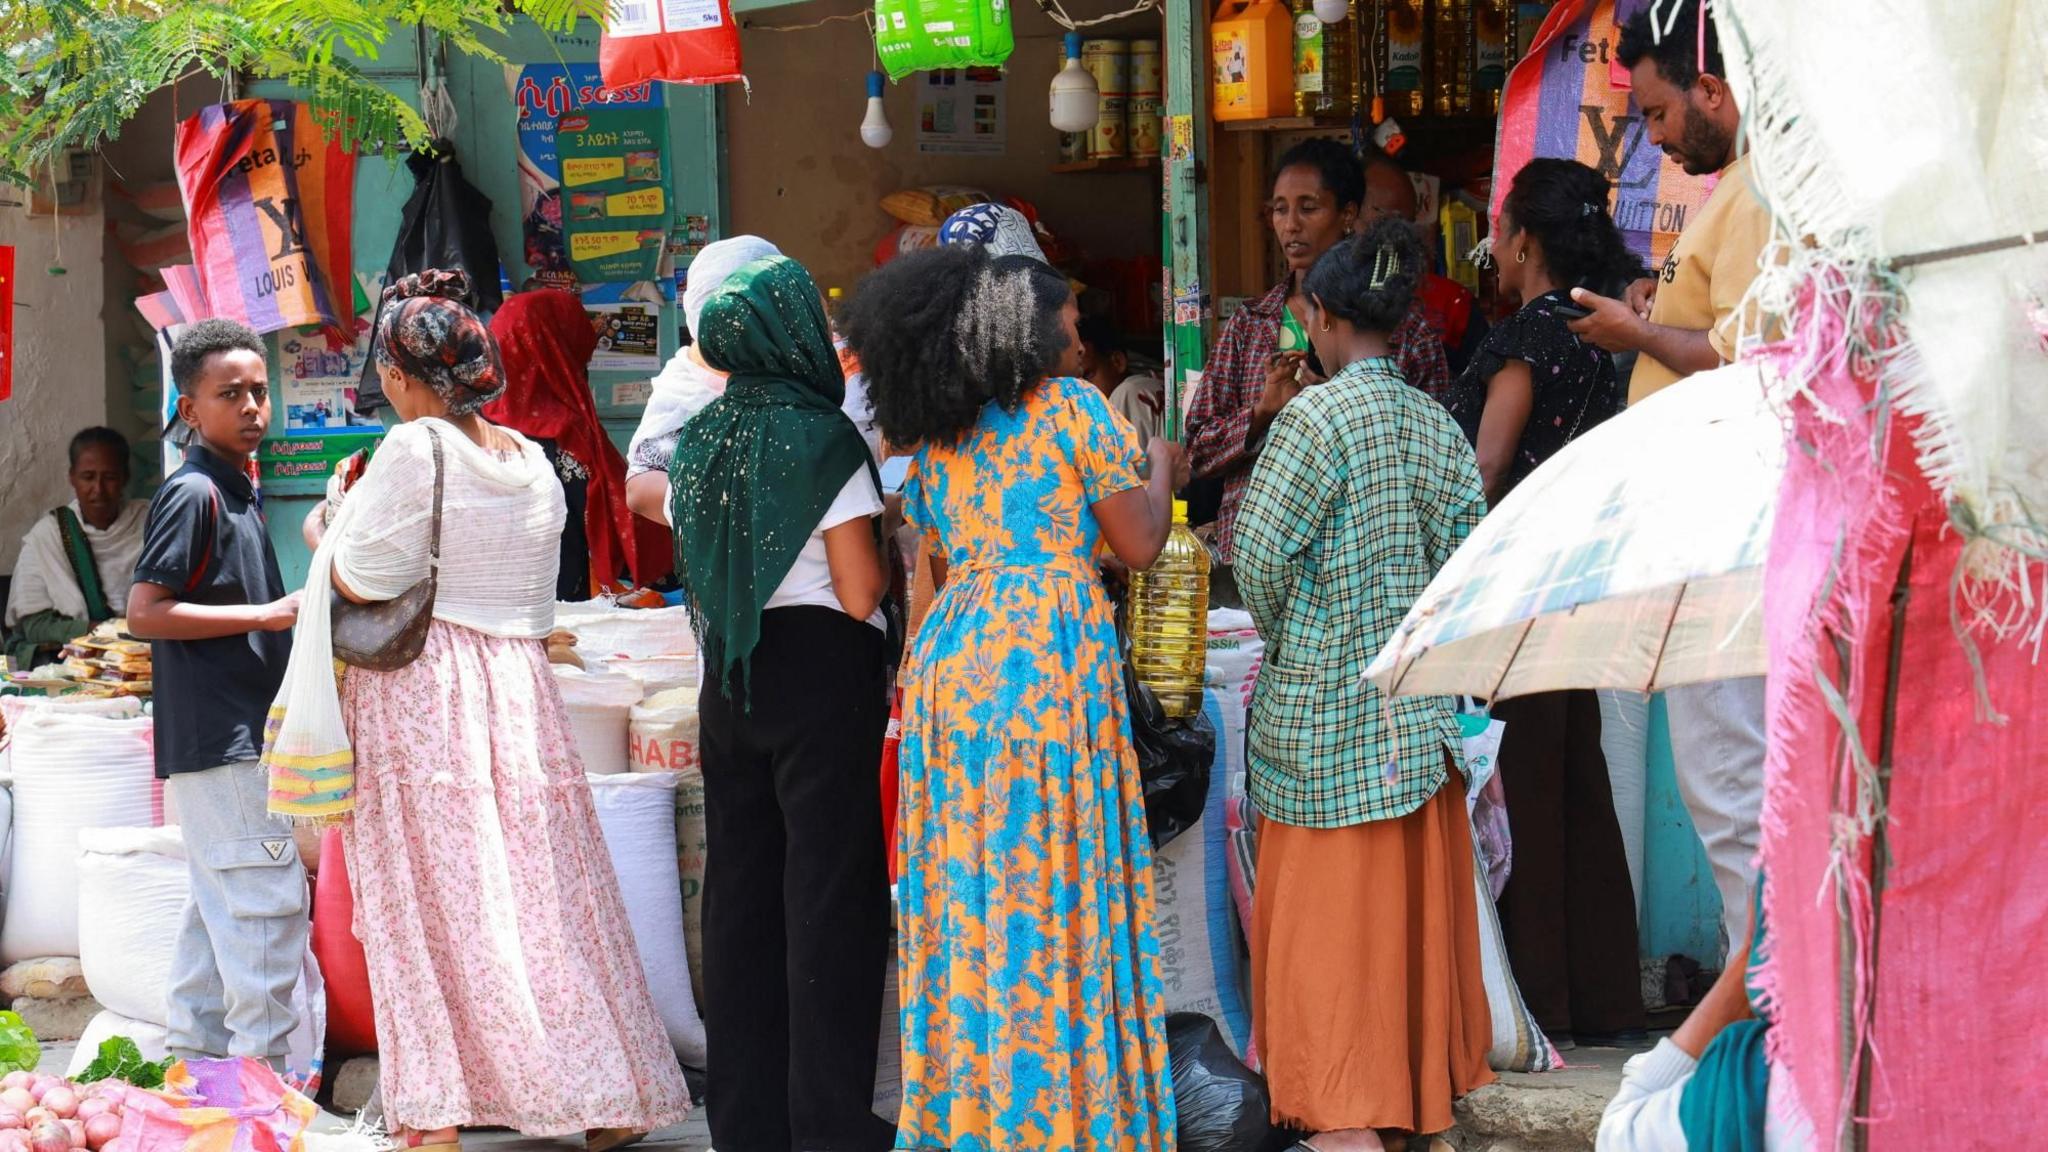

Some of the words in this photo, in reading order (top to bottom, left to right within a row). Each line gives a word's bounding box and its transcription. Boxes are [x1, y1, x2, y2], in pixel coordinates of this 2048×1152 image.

[702, 13, 719, 22] 5kg
[576, 134, 585, 147] 3
[255, 265, 295, 298] LOUIS
[628, 731, 702, 770] HAB
